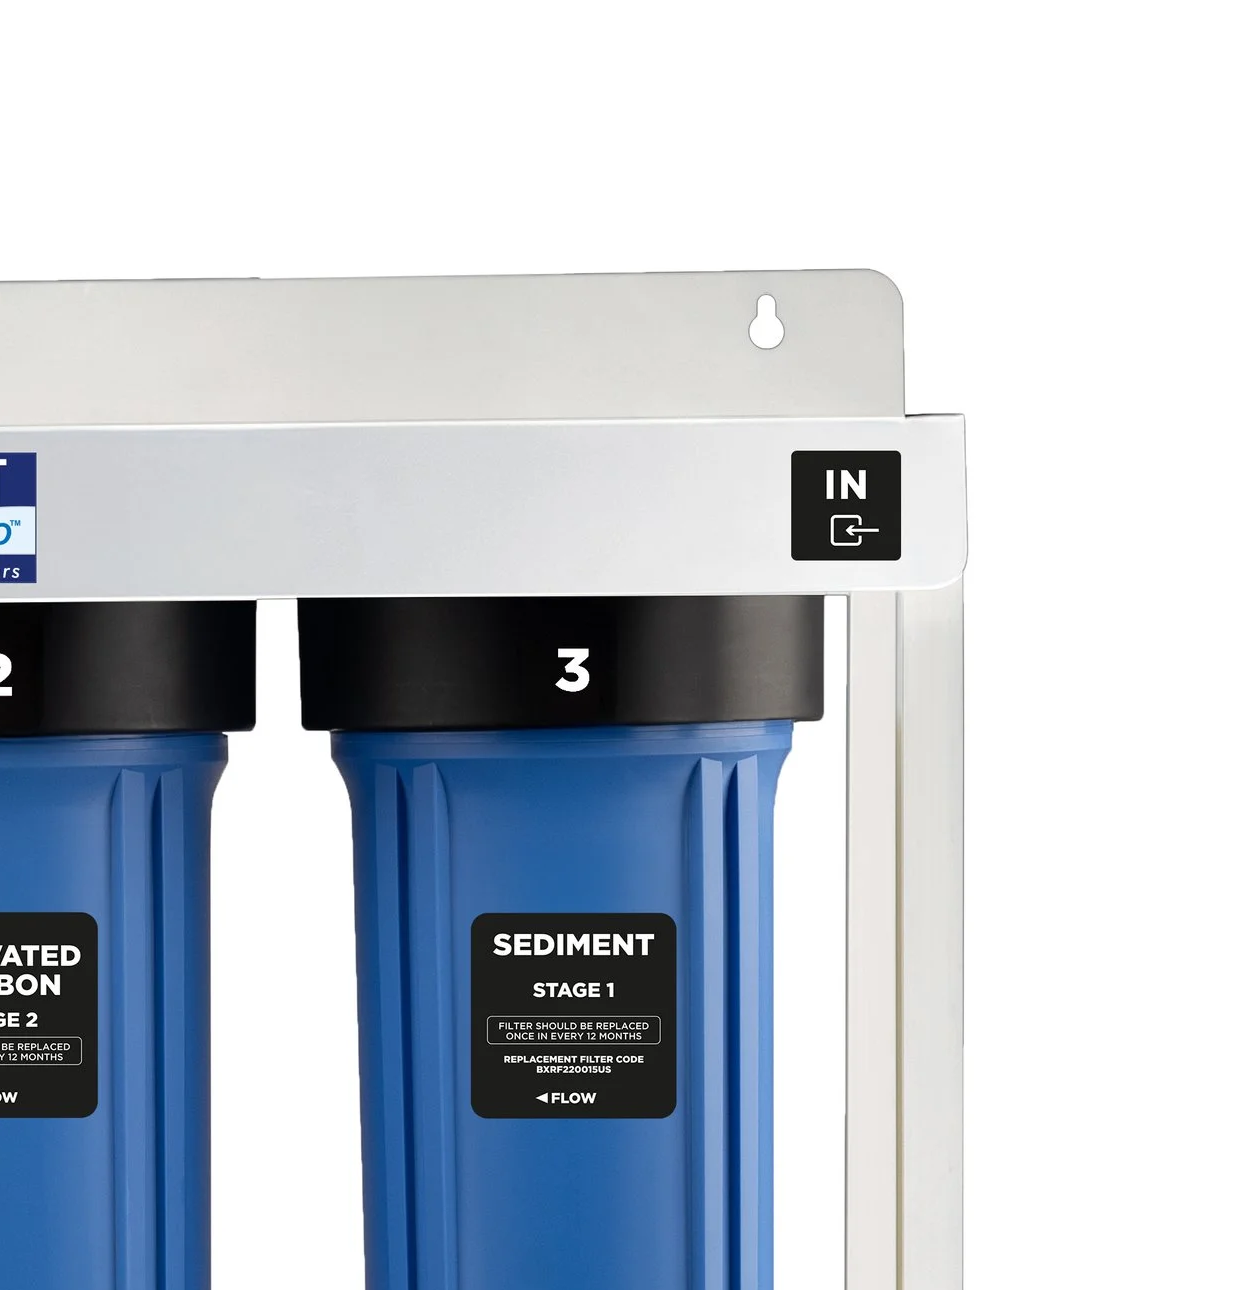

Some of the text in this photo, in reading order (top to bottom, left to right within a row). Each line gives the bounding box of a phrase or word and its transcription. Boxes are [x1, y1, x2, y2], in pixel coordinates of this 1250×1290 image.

[826, 470, 866, 499] IN
[556, 649, 589, 692] 3
[493, 933, 654, 956] SEDIMENT
[533, 982, 614, 997] STAGE 1
[26, 1012, 38, 1027] 2
[499, 1022, 649, 1030] FILTER SHOULD BE REPLACED
[506, 1032, 534, 1040] ONCE
[551, 1032, 583, 1040] EVERY
[587, 1032, 596, 1040] 12
[599, 1032, 642, 1040] MONTHS
[8, 1053, 17, 1061] 12
[21, 1053, 63, 1061] MONTHS
[552, 1093, 596, 1104] FLOW
